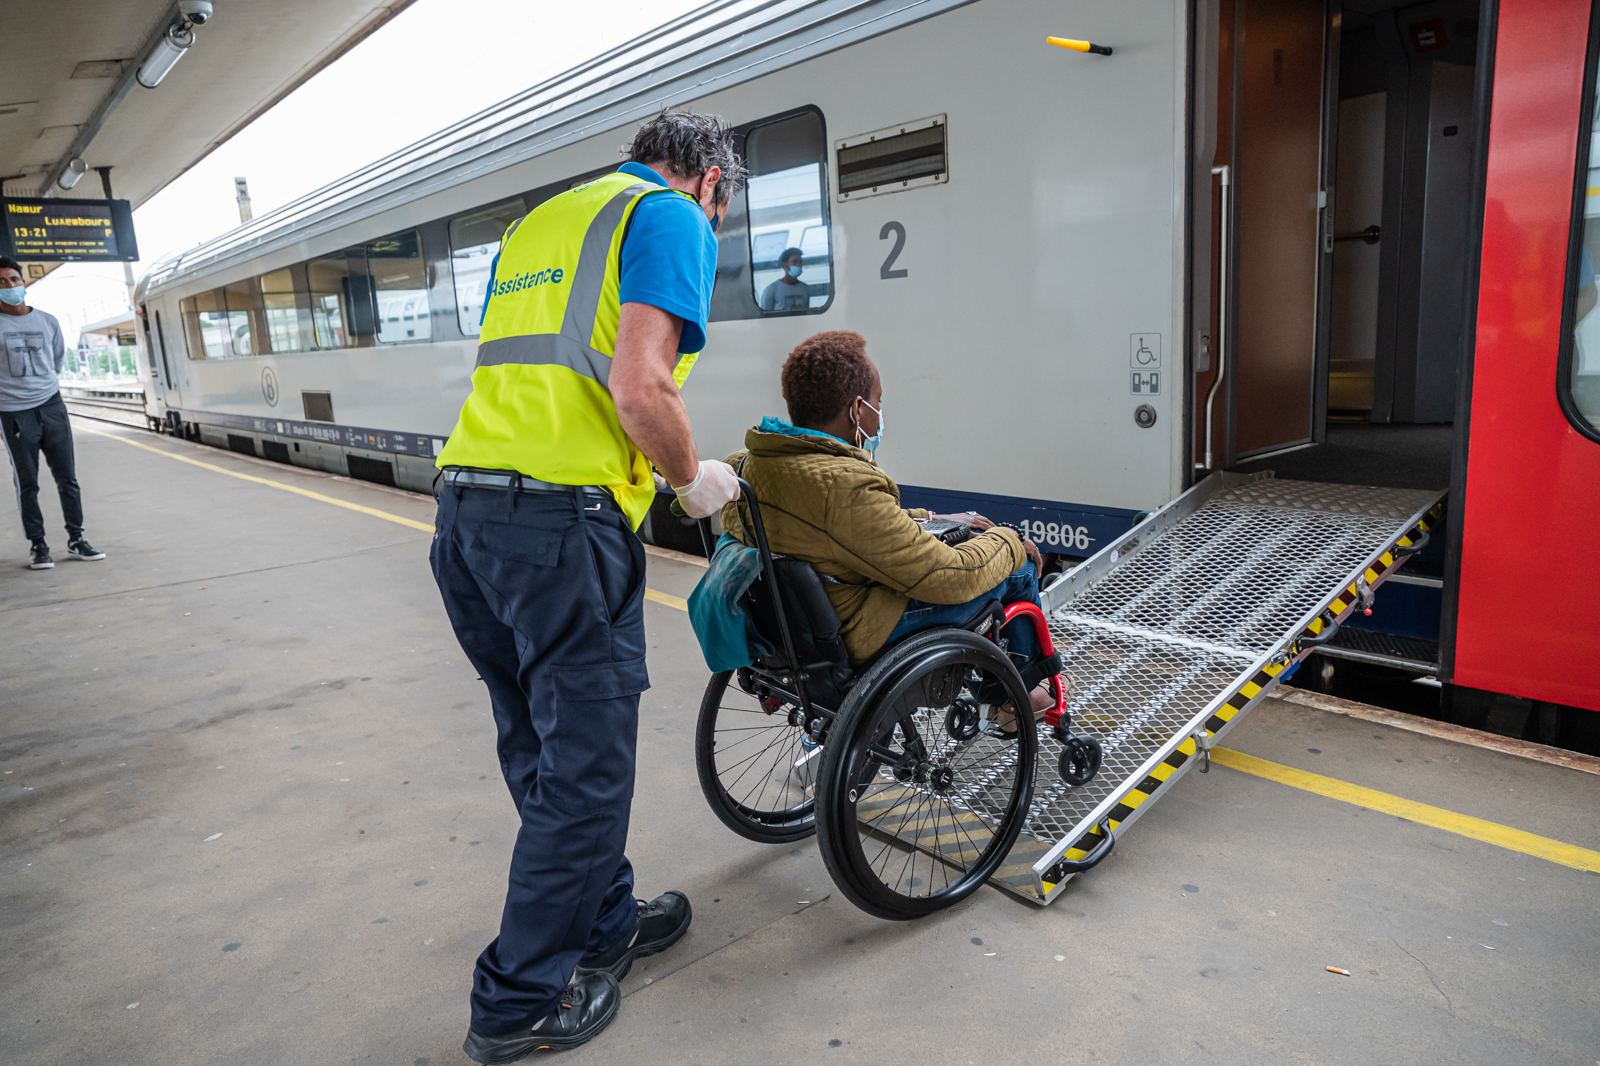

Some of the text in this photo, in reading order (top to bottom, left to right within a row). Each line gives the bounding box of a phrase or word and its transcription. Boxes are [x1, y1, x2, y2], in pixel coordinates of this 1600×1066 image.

[8, 204, 43, 213] Namur
[44, 216, 111, 226] Luxembourg
[14, 228, 47, 237] 13:21
[879, 220, 908, 280] 2
[492, 268, 564, 296] Assistance
[1020, 519, 1090, 550] 19806
